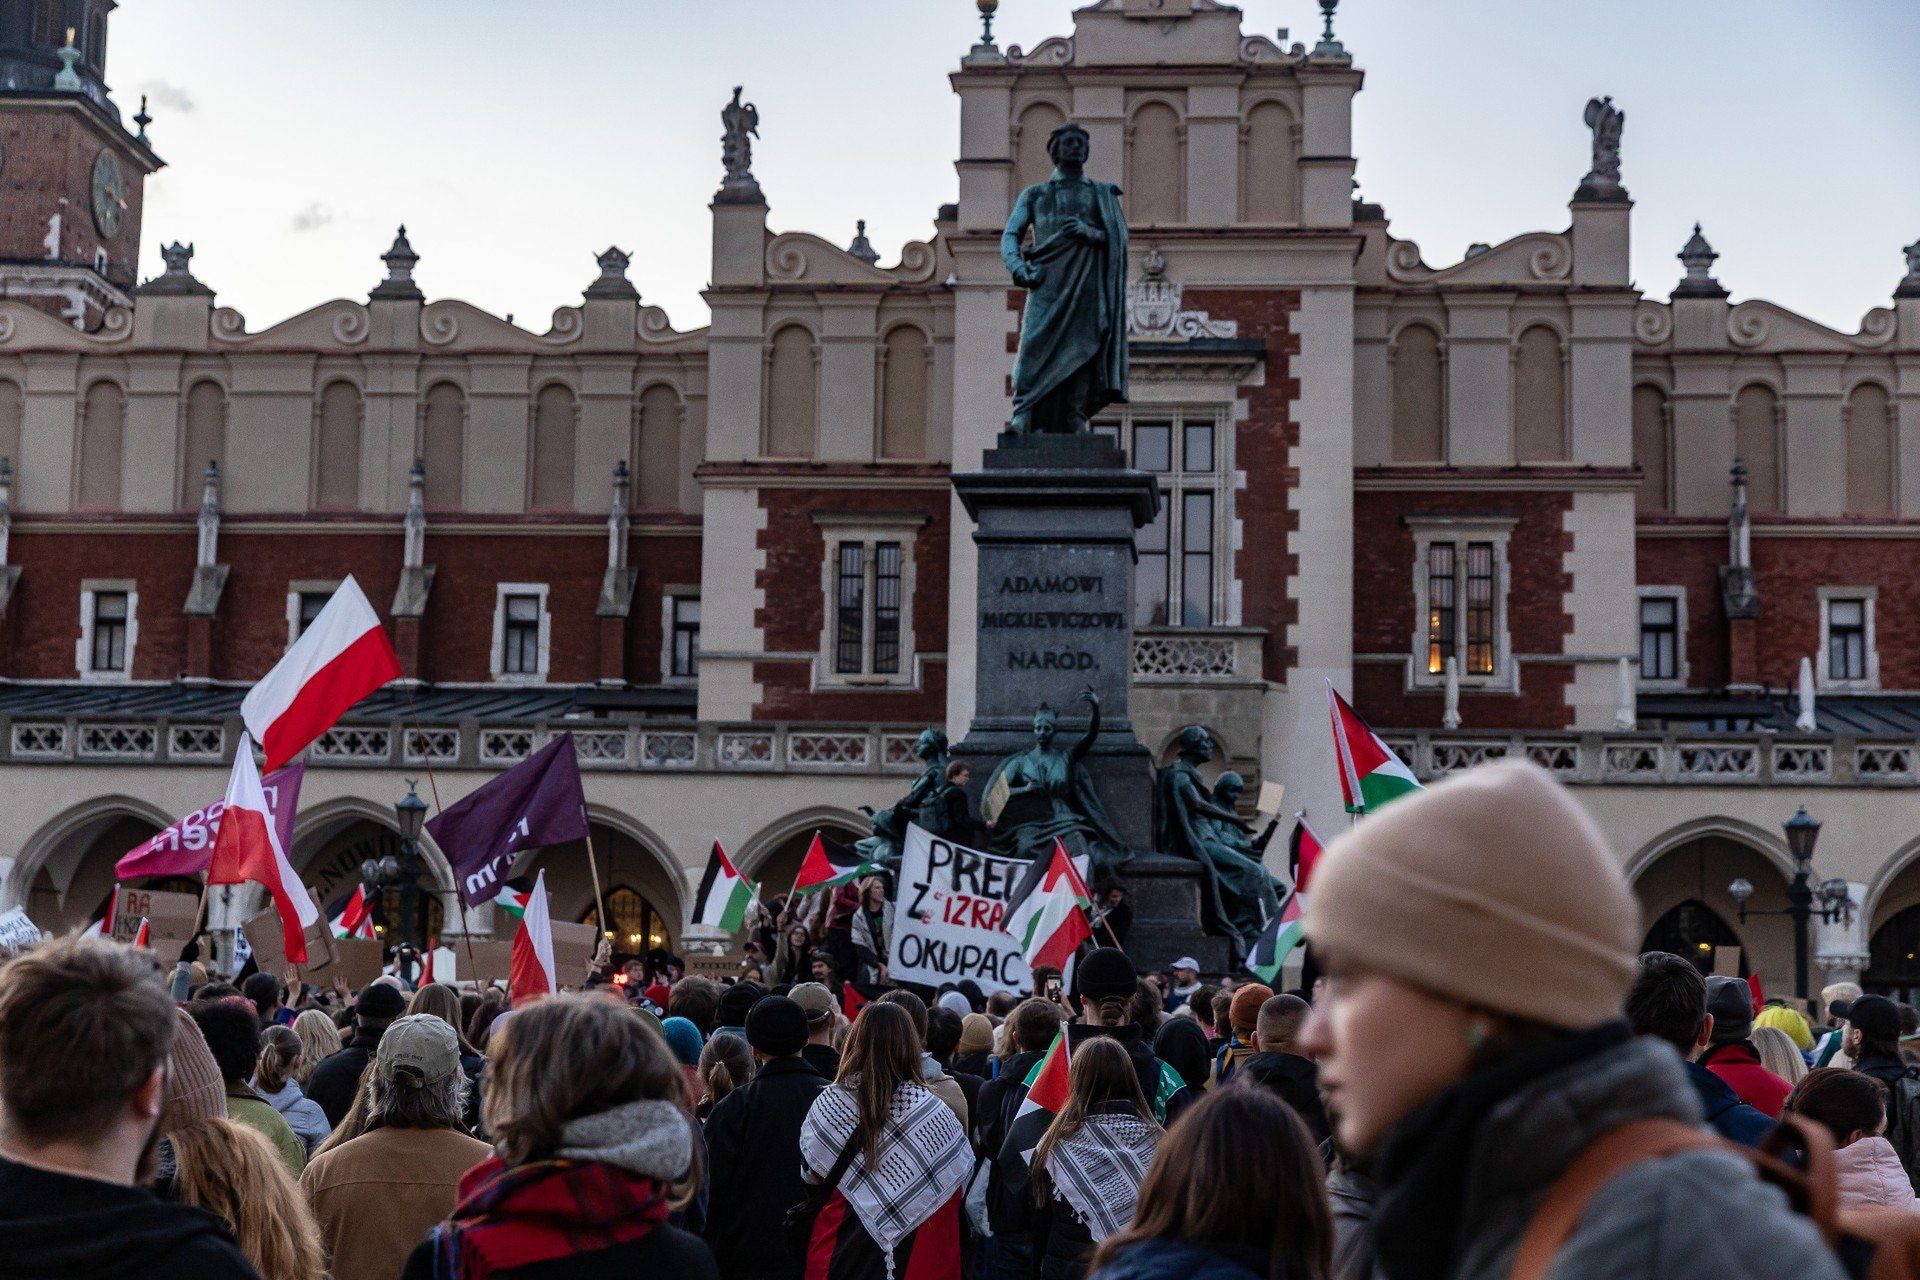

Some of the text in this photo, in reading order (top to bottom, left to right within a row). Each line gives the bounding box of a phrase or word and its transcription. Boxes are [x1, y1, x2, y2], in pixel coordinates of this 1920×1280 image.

[1000, 576, 1102, 593] ADAMOWI
[982, 612, 1123, 630] MICKIEWICZOWI
[908, 882, 1008, 934] Z IZRA
[899, 934, 1028, 990] OKUPAC
